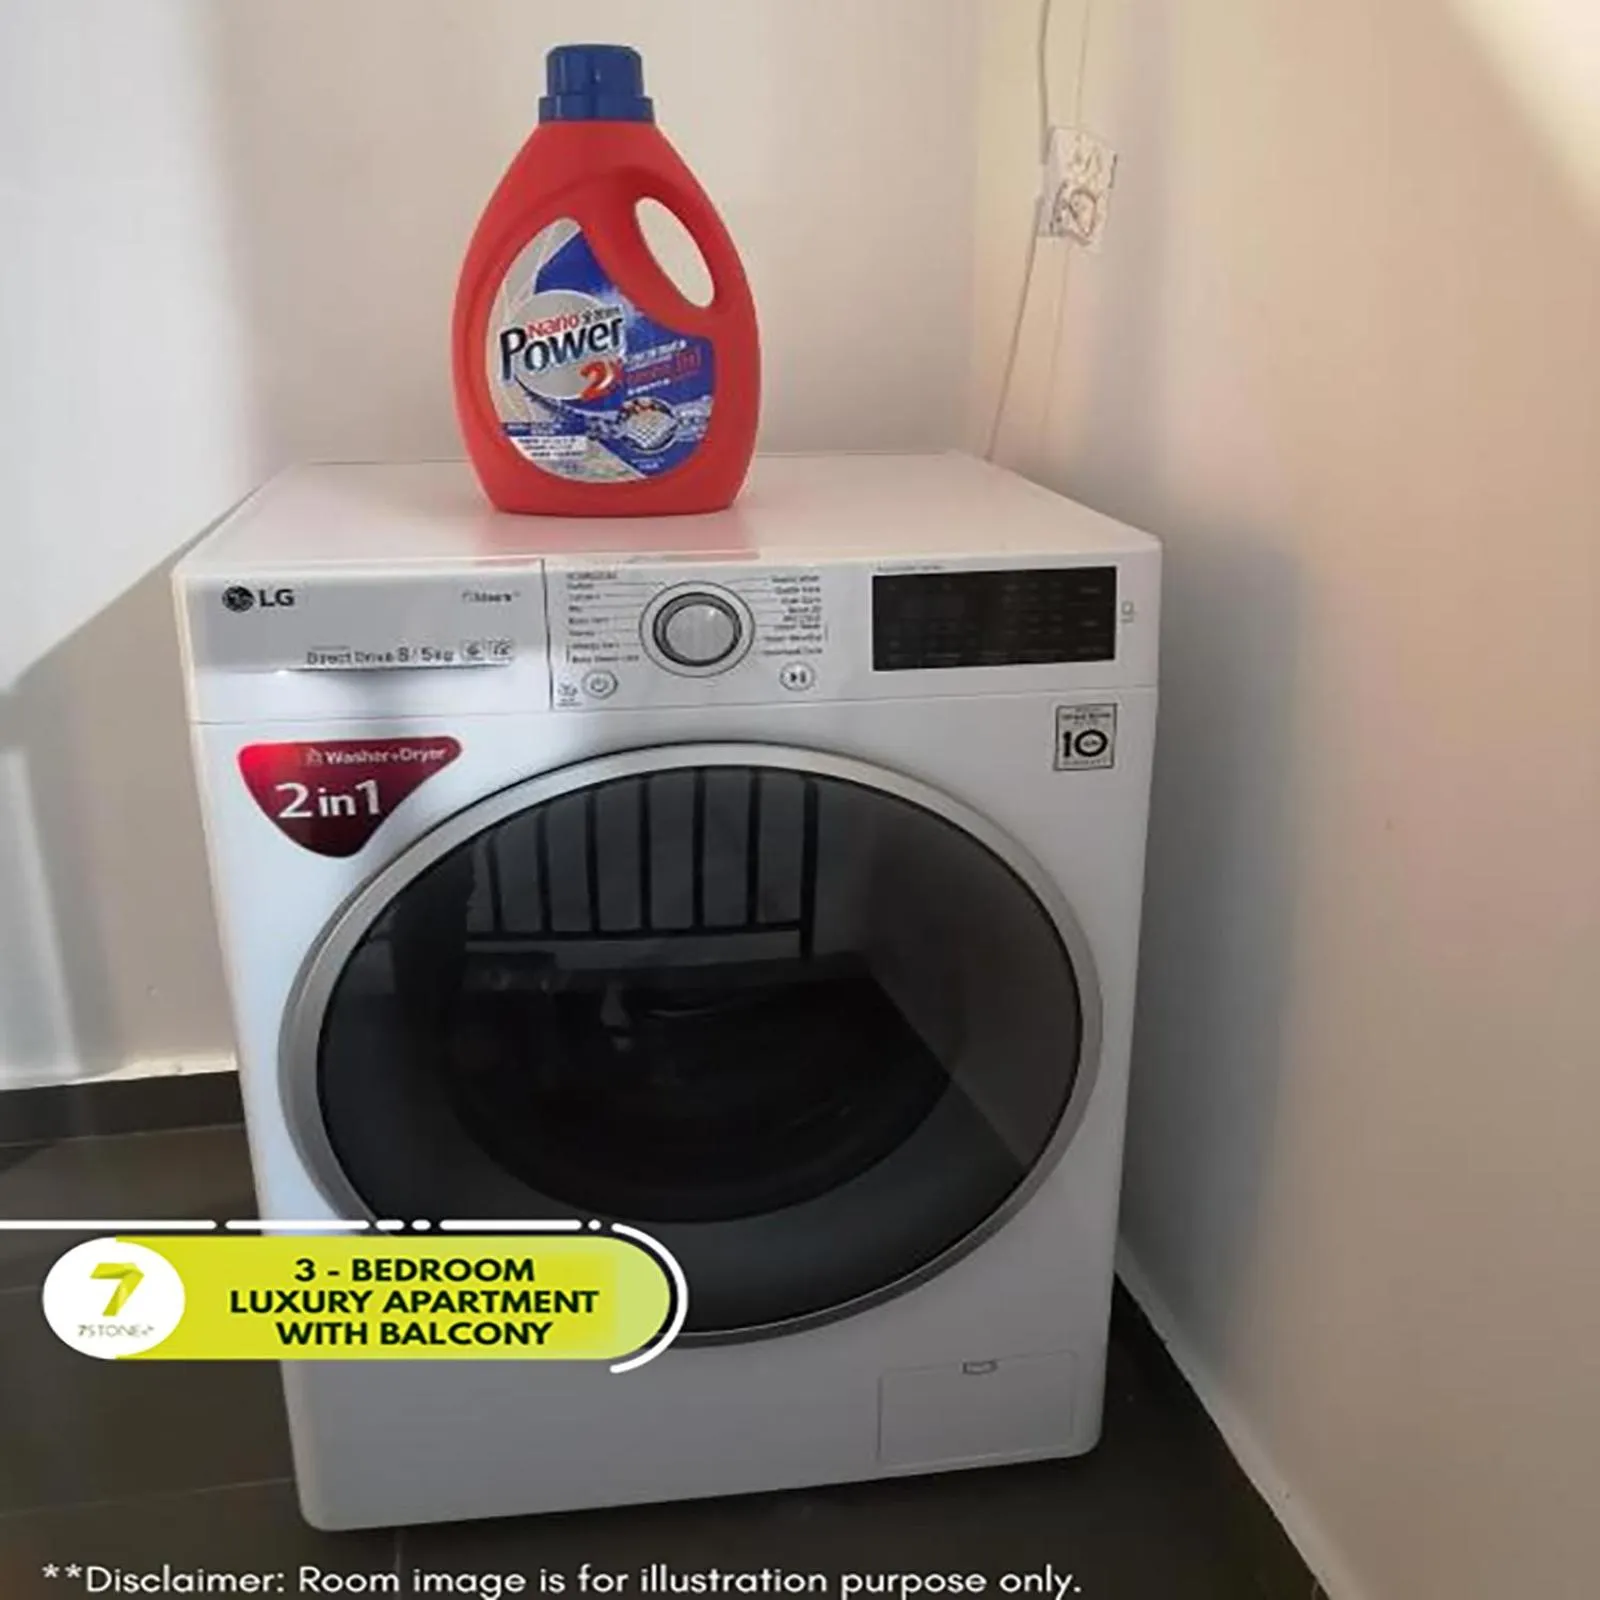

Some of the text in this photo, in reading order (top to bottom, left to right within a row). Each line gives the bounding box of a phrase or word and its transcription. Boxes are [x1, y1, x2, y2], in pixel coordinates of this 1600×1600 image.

[527, 314, 580, 338] Nano
[500, 317, 624, 381] Power
[260, 588, 295, 607] LG
[1062, 729, 1108, 759] 10
[275, 779, 381, 819] 2 in 1
